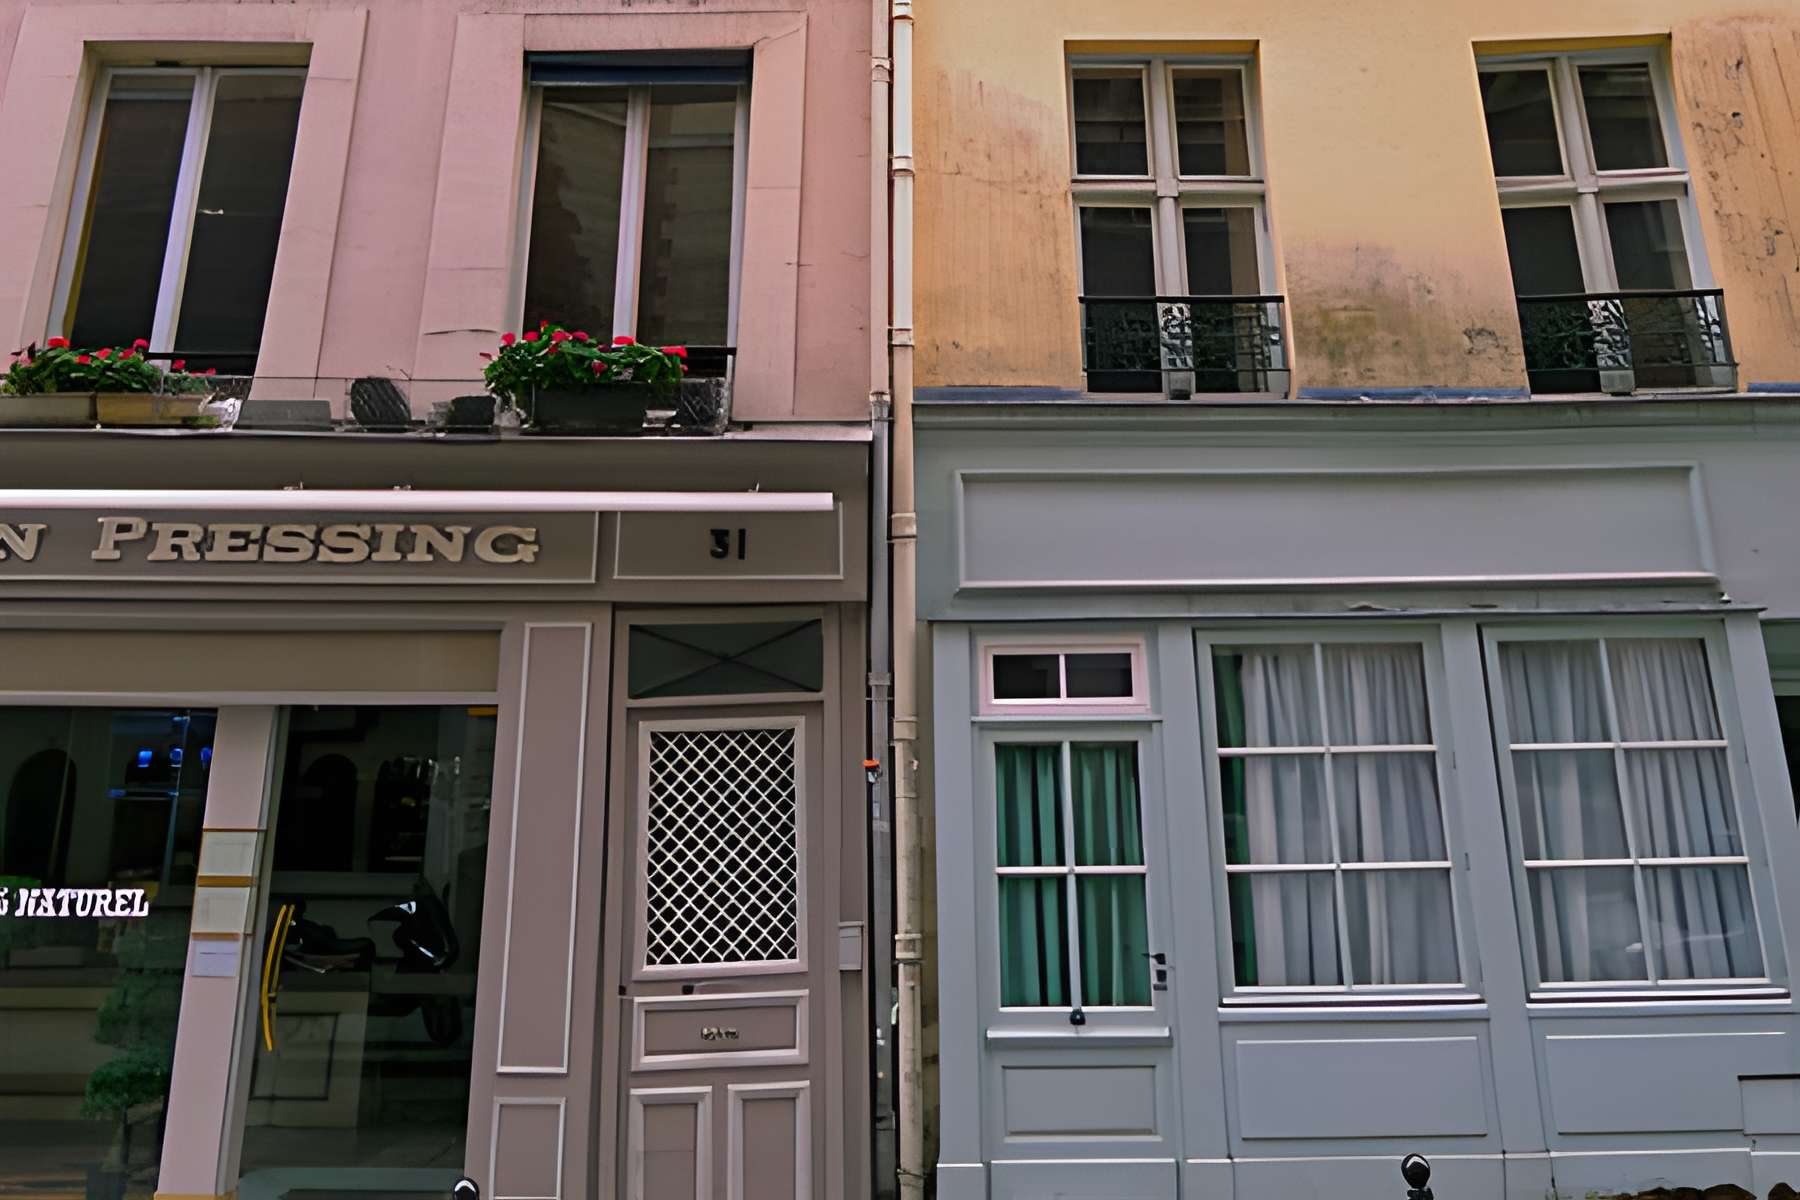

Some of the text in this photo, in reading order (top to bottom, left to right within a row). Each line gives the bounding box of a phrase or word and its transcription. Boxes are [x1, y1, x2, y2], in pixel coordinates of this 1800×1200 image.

[91, 516, 539, 563] PRESSING
[710, 528, 747, 560] 31
[14, 888, 149, 917] NATUREL
